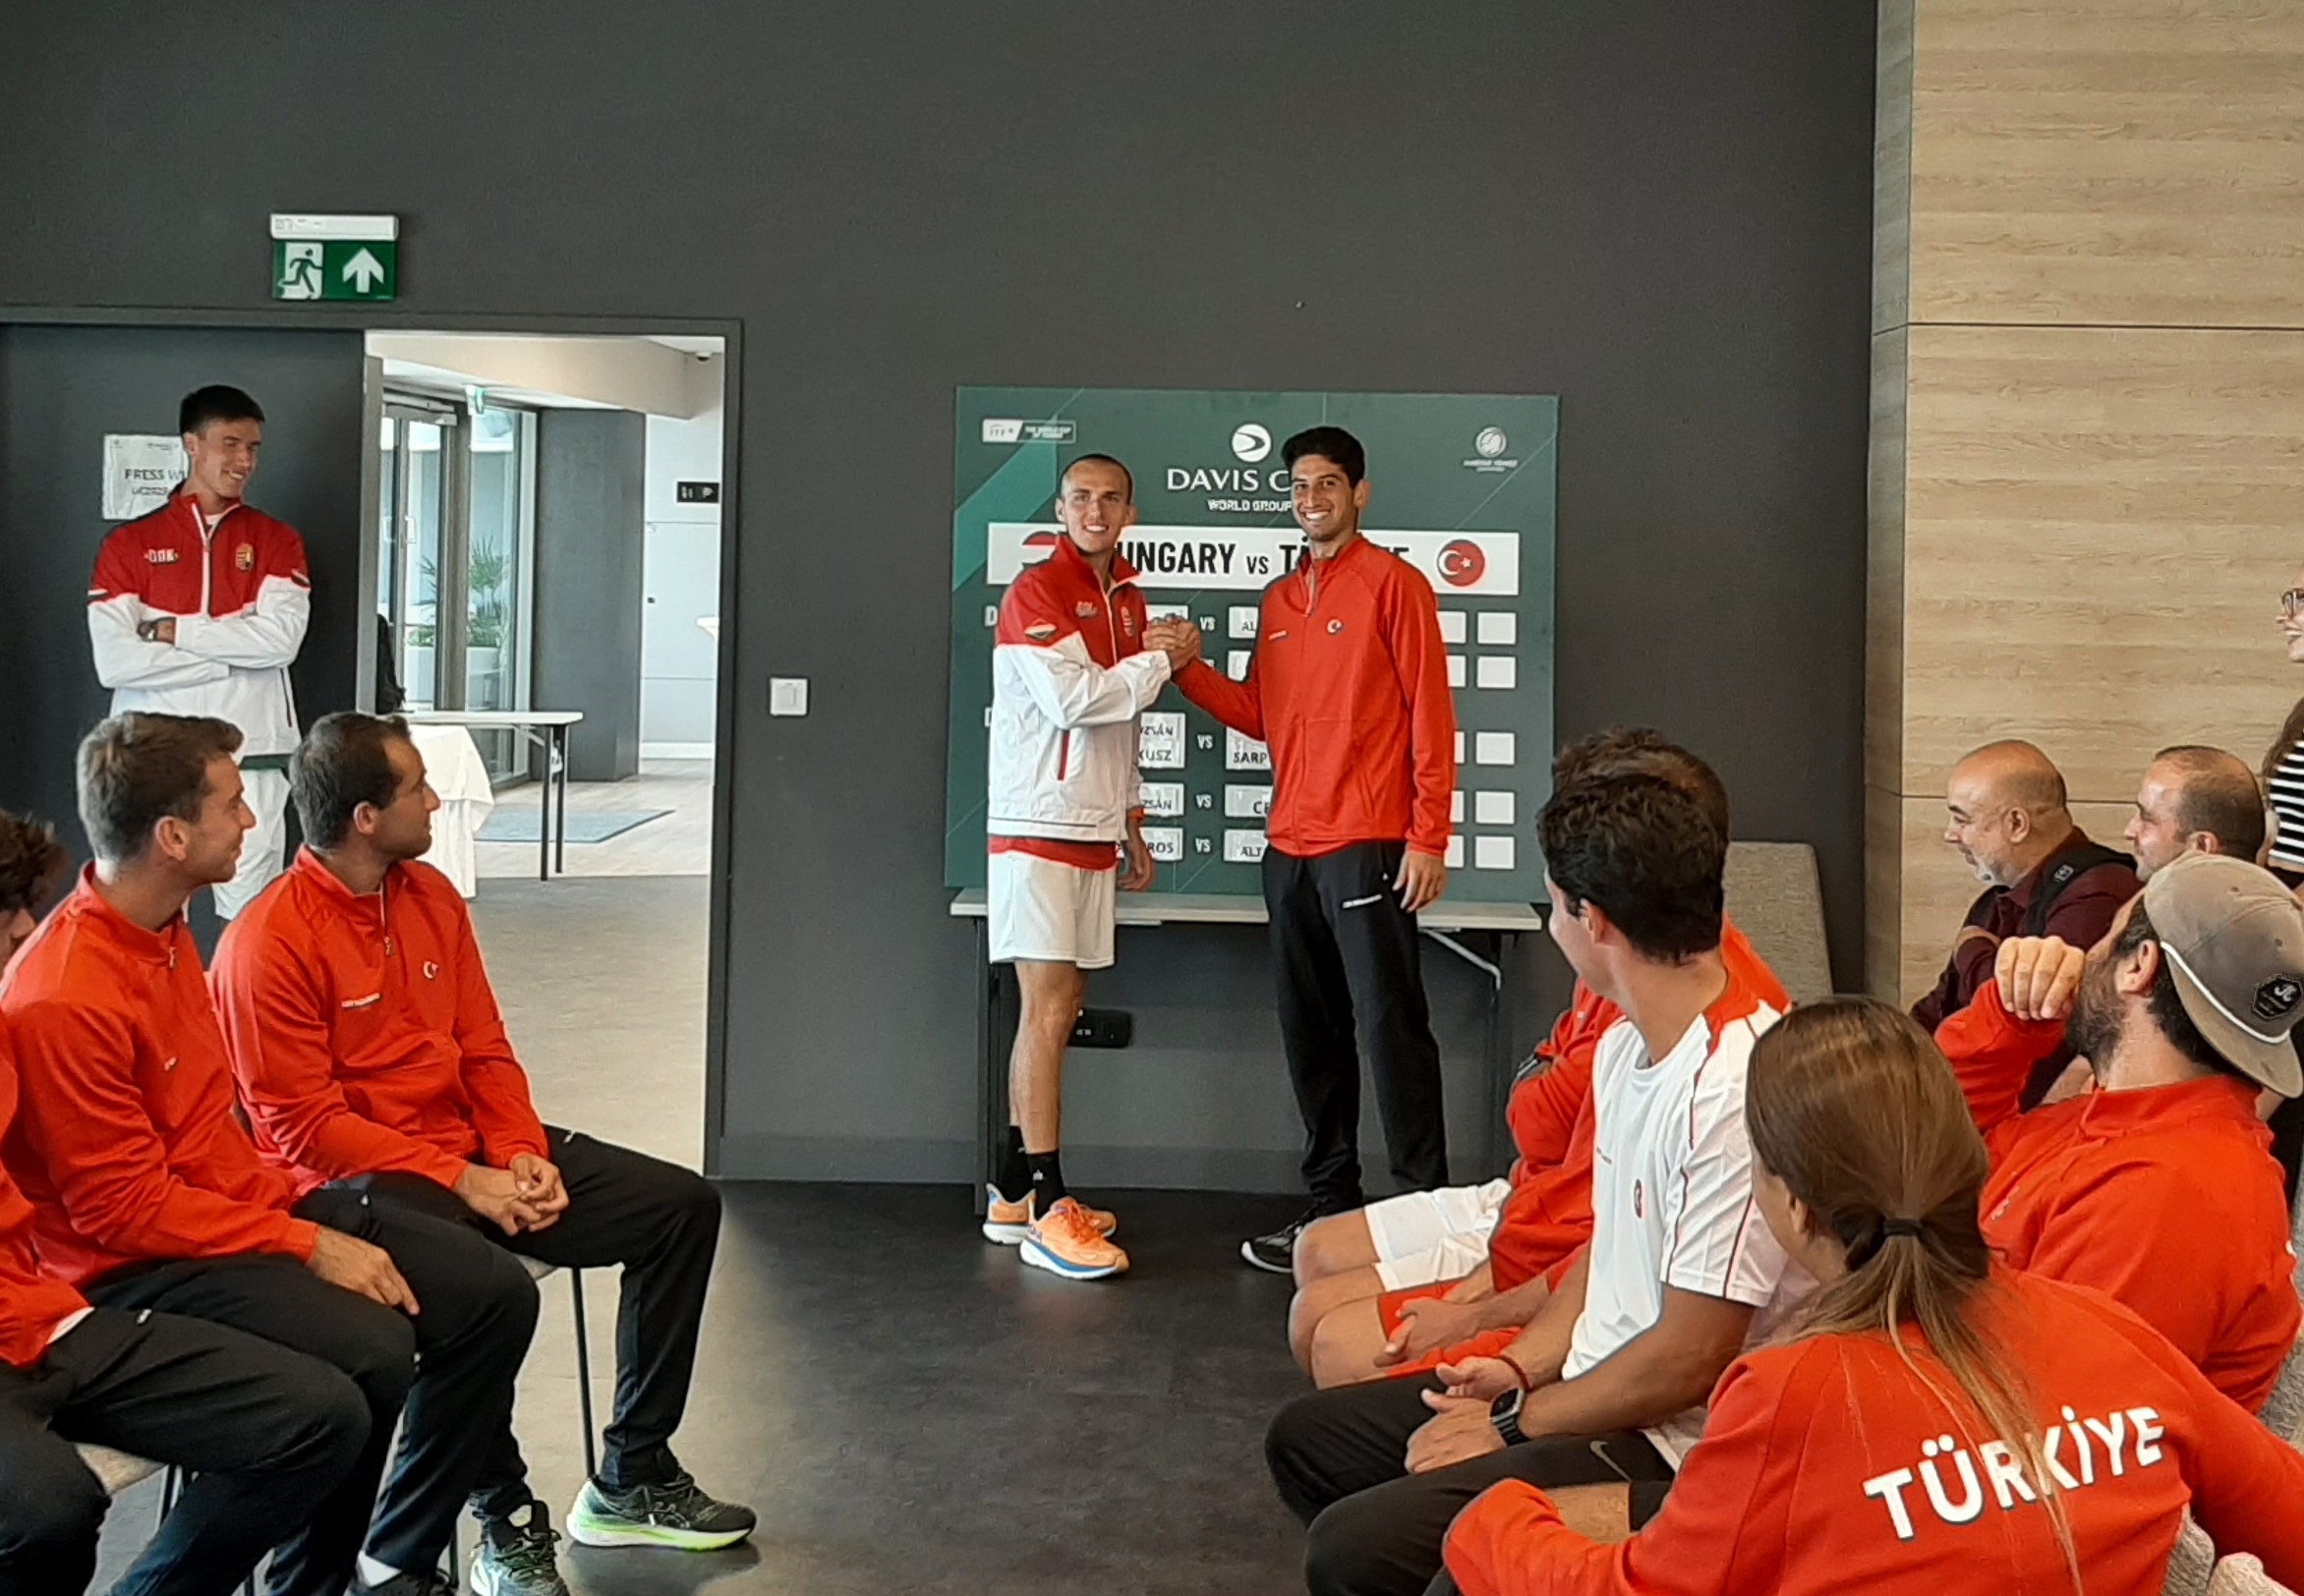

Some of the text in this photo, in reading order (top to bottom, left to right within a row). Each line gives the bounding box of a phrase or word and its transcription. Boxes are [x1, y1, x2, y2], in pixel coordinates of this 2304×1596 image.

[125, 469, 165, 481] PRESS
[1167, 468, 1292, 492] DAVIS C
[1207, 498, 1250, 511] WORLD
[1117, 542, 1237, 575] UNGARY
[1246, 555, 1270, 575] VS
[1199, 615, 1216, 631] VS
[1140, 723, 1174, 736] ZSÁN
[1196, 734, 1214, 750] VS
[1142, 797, 1173, 810] ZSÁN
[1195, 794, 1213, 810] VS
[1147, 841, 1175, 854] ROS
[1195, 837, 1212, 853] VS
[1240, 846, 1262, 858] ALT
[1863, 1404, 2164, 1540] TÜRKİYE
